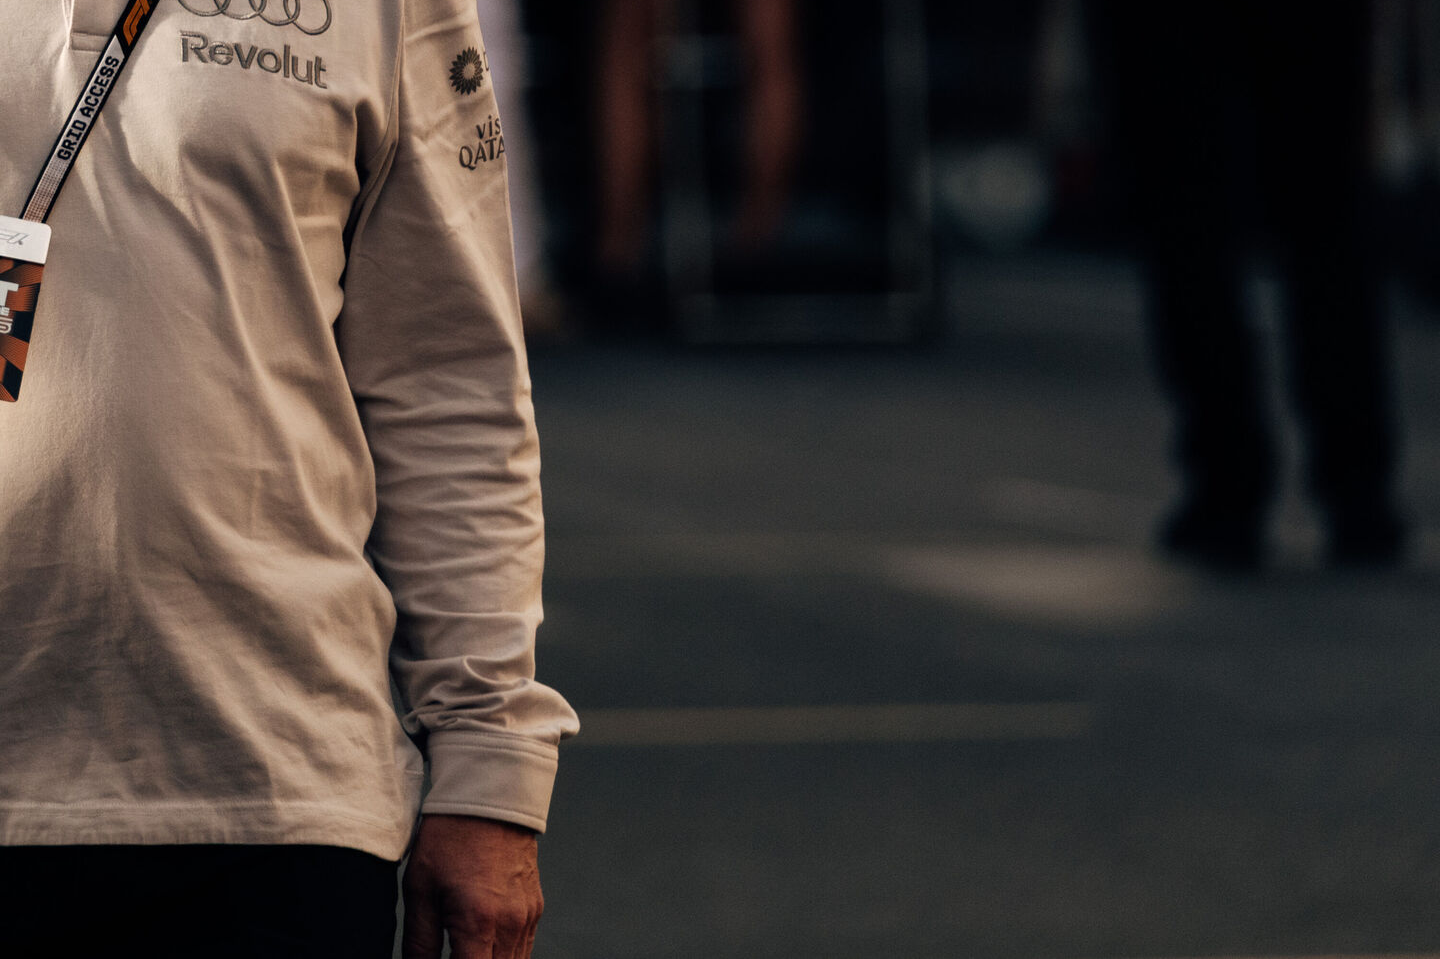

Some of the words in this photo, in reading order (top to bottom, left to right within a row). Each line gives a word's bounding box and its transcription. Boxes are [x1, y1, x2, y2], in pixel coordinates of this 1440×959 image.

[179, 29, 329, 90] Revolut
[57, 118, 87, 161] GRID
[79, 55, 120, 119] ACCESS
